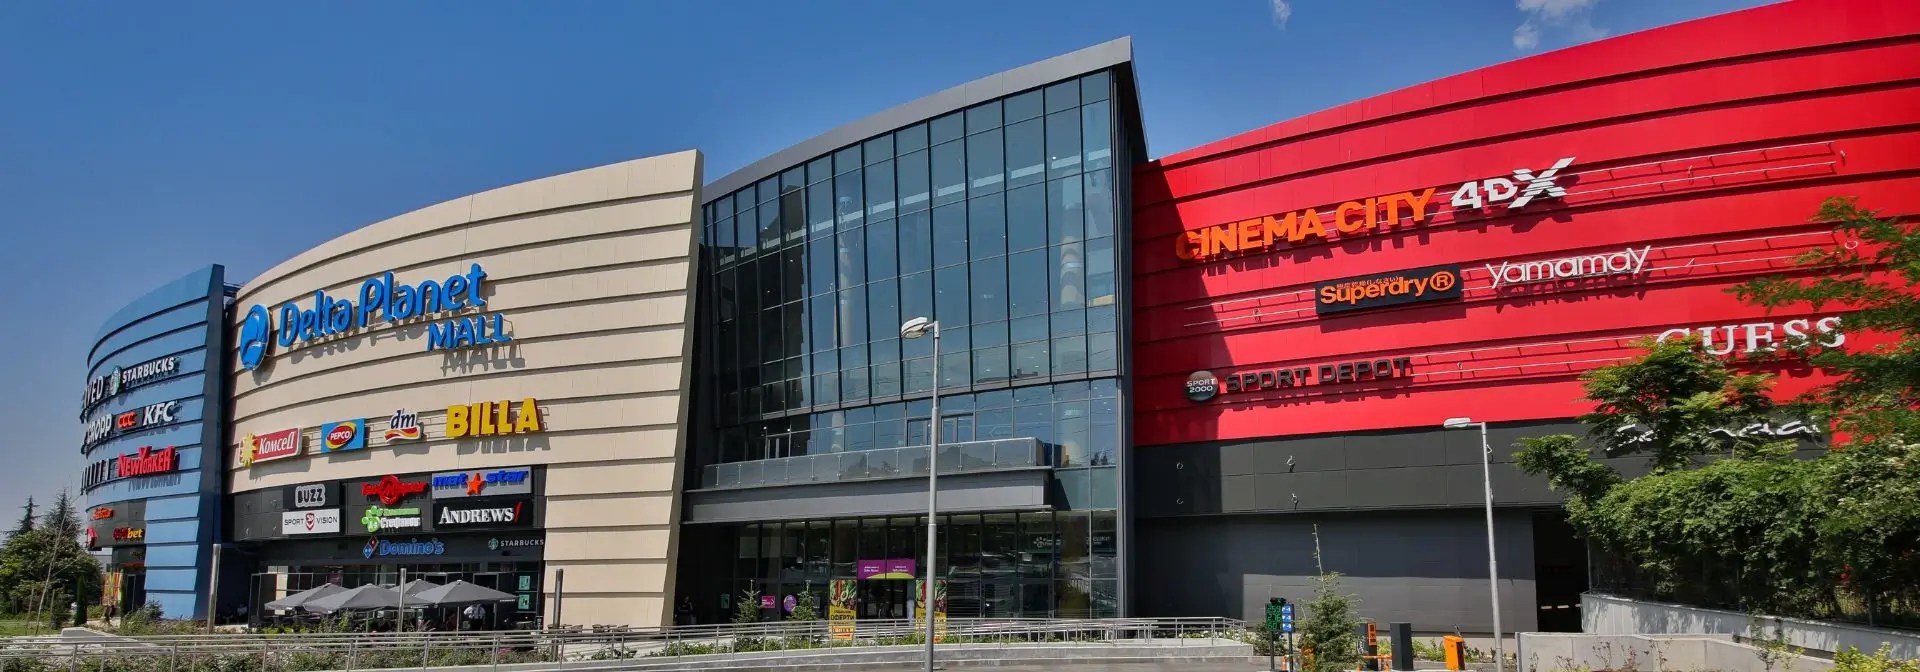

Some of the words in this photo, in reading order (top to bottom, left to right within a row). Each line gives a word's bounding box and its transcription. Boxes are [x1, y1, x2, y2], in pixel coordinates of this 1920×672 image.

[1176, 208, 1327, 262] CINEMA
[1335, 187, 1437, 234] CITY
[1450, 156, 1576, 210] 4DX
[278, 289, 353, 347] Delta
[358, 263, 488, 328] Planet
[427, 313, 514, 352] MALL
[122, 357, 175, 384] STARBUCKS
[1226, 366, 1311, 392] SPORT
[1318, 356, 1411, 383] DEPOT
[1186, 378, 1216, 388] SPORT
[1189, 385, 1214, 393] 2000
[142, 402, 175, 426] KFC
[391, 409, 416, 430] dm
[446, 398, 539, 438] BILLA
[330, 430, 351, 440] PEPCO
[297, 488, 323, 503] BUZZ
[284, 518, 304, 526] SPORT
[438, 507, 515, 524] ANDREWS
[379, 538, 445, 556] Domino's
[500, 539, 544, 547] STARBUCKS
